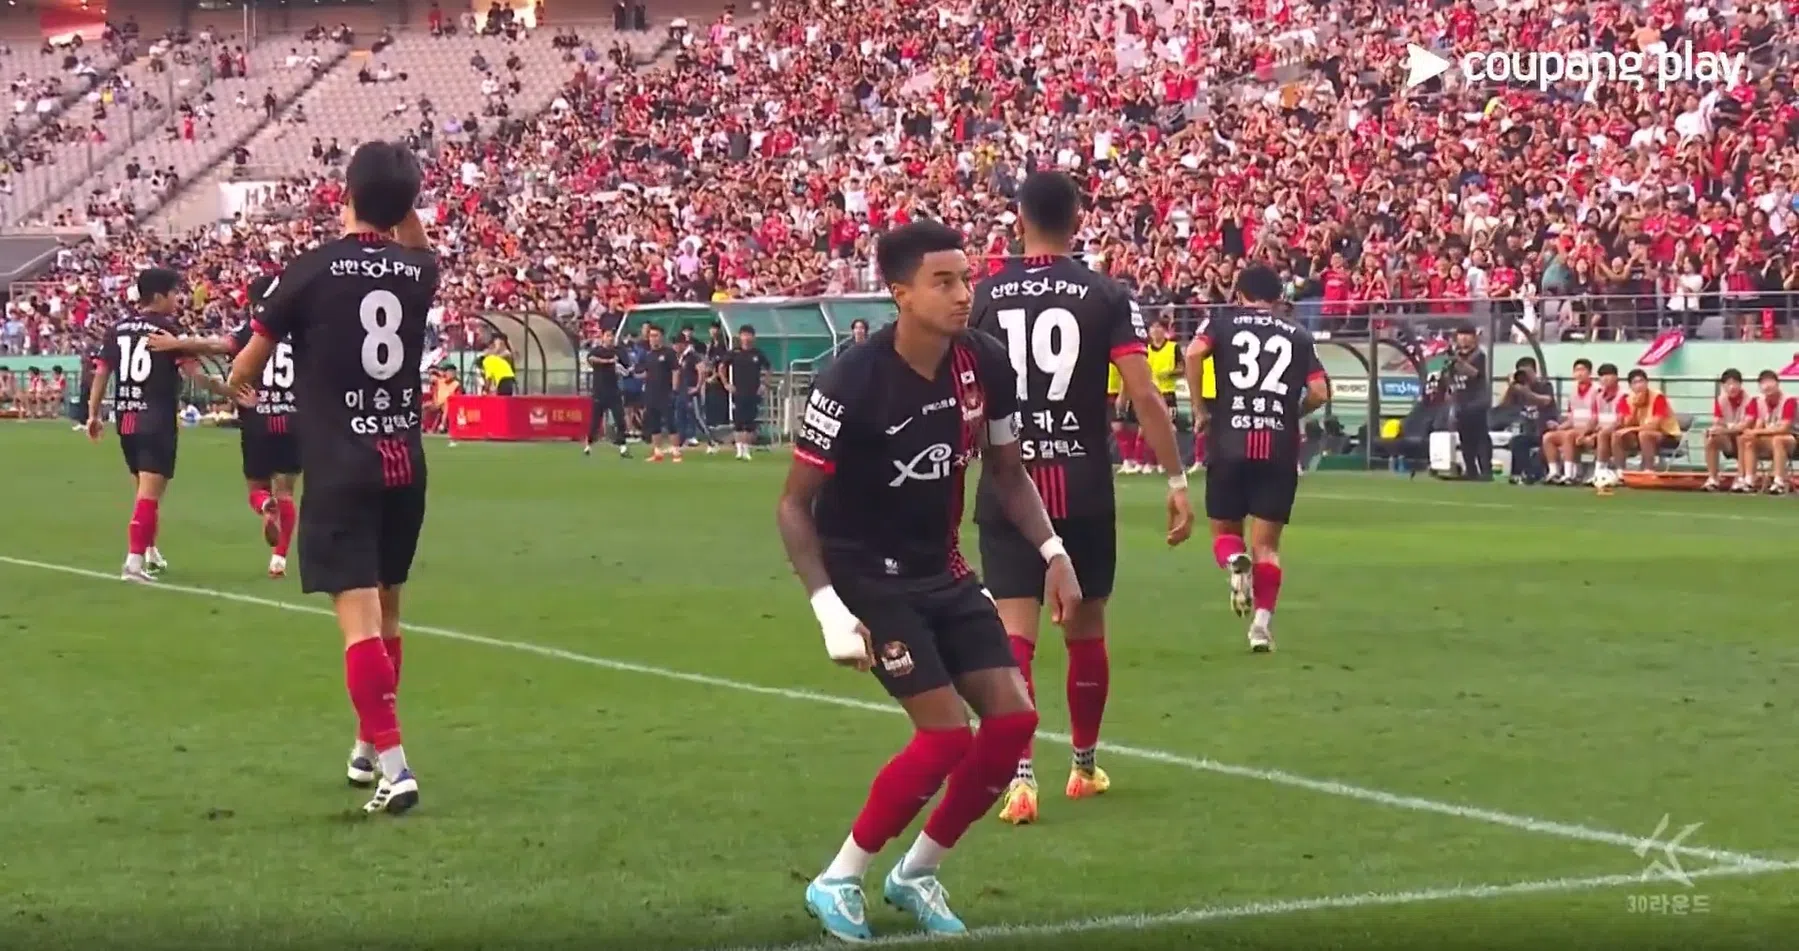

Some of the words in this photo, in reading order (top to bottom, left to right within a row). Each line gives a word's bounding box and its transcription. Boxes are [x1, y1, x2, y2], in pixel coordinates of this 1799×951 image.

[361, 257, 392, 278] SOL
[393, 261, 421, 281] Pay
[1022, 277, 1053, 295] SOL
[1055, 280, 1089, 299] Pay
[359, 289, 404, 381] 8
[117, 335, 152, 383] 16
[997, 307, 1081, 401] 19
[1228, 330, 1293, 395] 32
[818, 396, 845, 418] KEF
[351, 418, 378, 434] GS
[1231, 415, 1251, 429] GS
